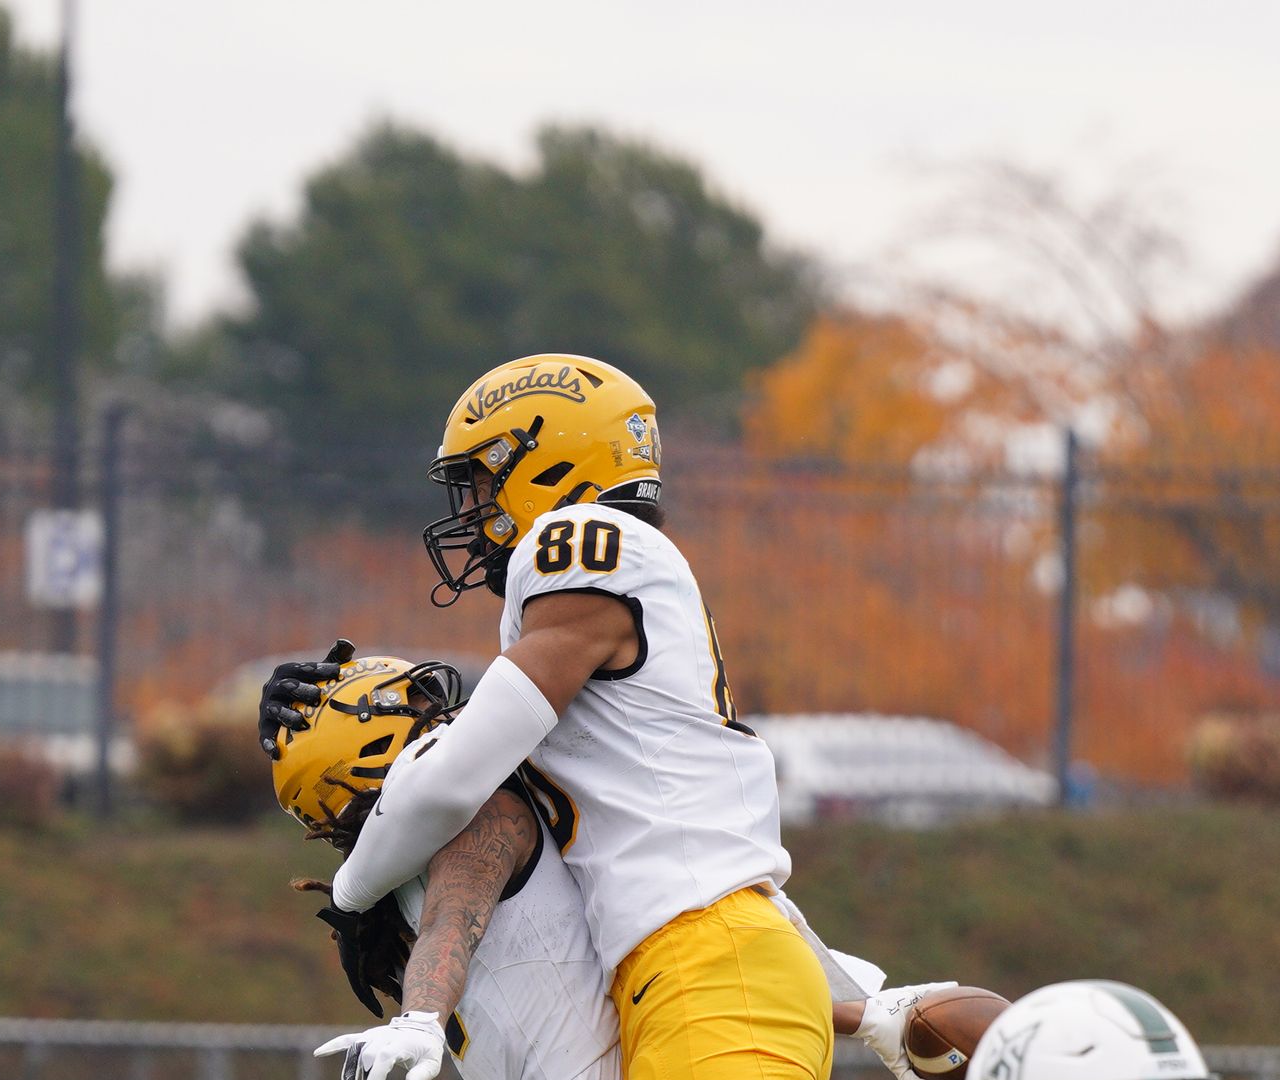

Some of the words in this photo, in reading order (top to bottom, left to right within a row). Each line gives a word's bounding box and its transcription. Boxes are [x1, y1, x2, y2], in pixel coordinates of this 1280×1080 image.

[467, 366, 582, 420] Vandals
[636, 482, 657, 499] BRAVE
[535, 520, 622, 575] 80
